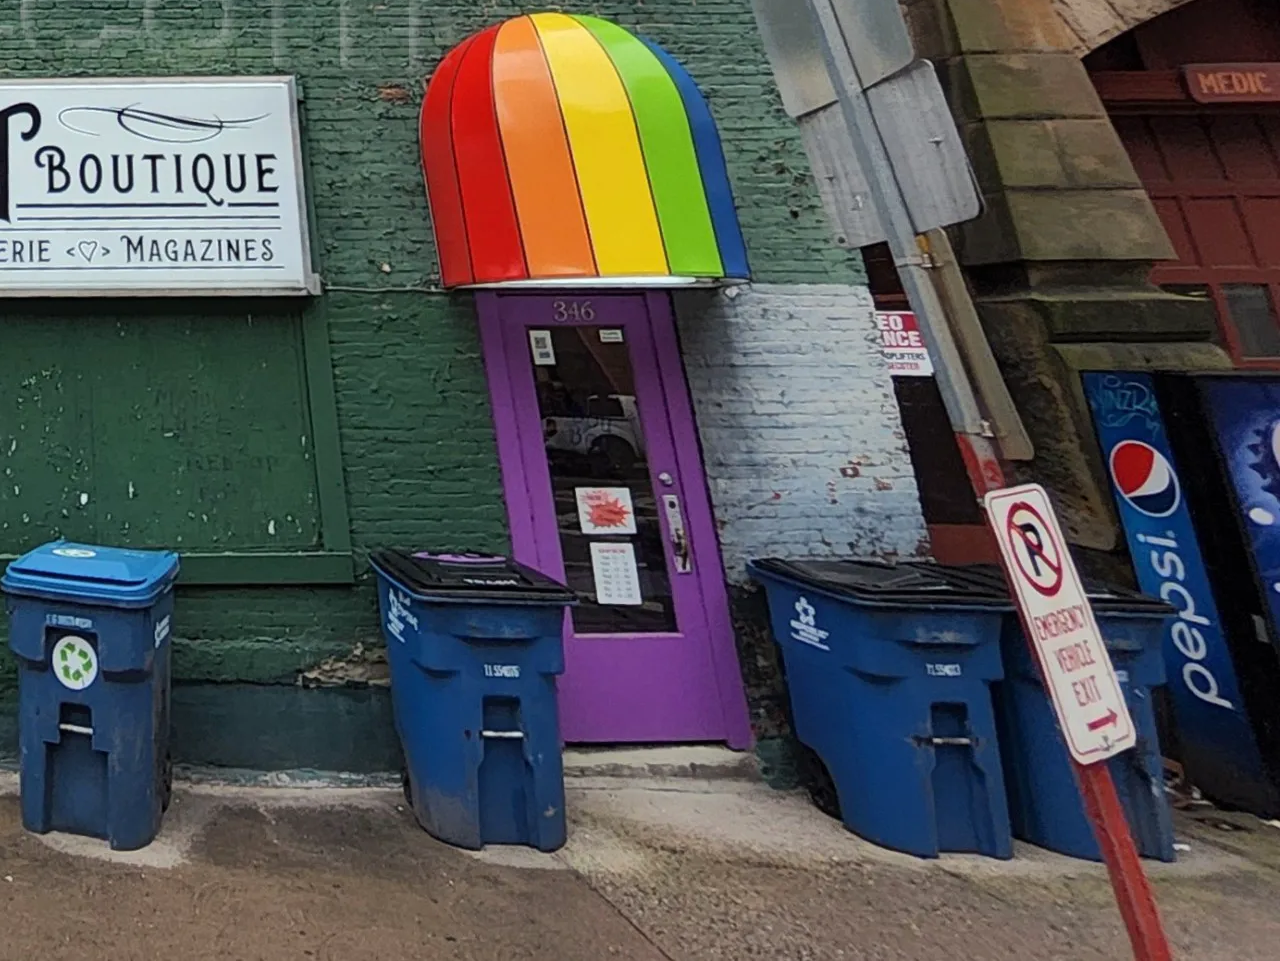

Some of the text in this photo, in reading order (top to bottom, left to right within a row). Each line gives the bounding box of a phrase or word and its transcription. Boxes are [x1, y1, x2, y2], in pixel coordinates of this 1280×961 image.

[1197, 72, 1271, 94] MEDIC
[34, 145, 279, 206] BOUTIQUE
[120, 235, 274, 262] MAGAZINES
[553, 301, 594, 321] 346
[1136, 531, 1234, 710] pepsi
[1072, 674, 1102, 707] EXIT
